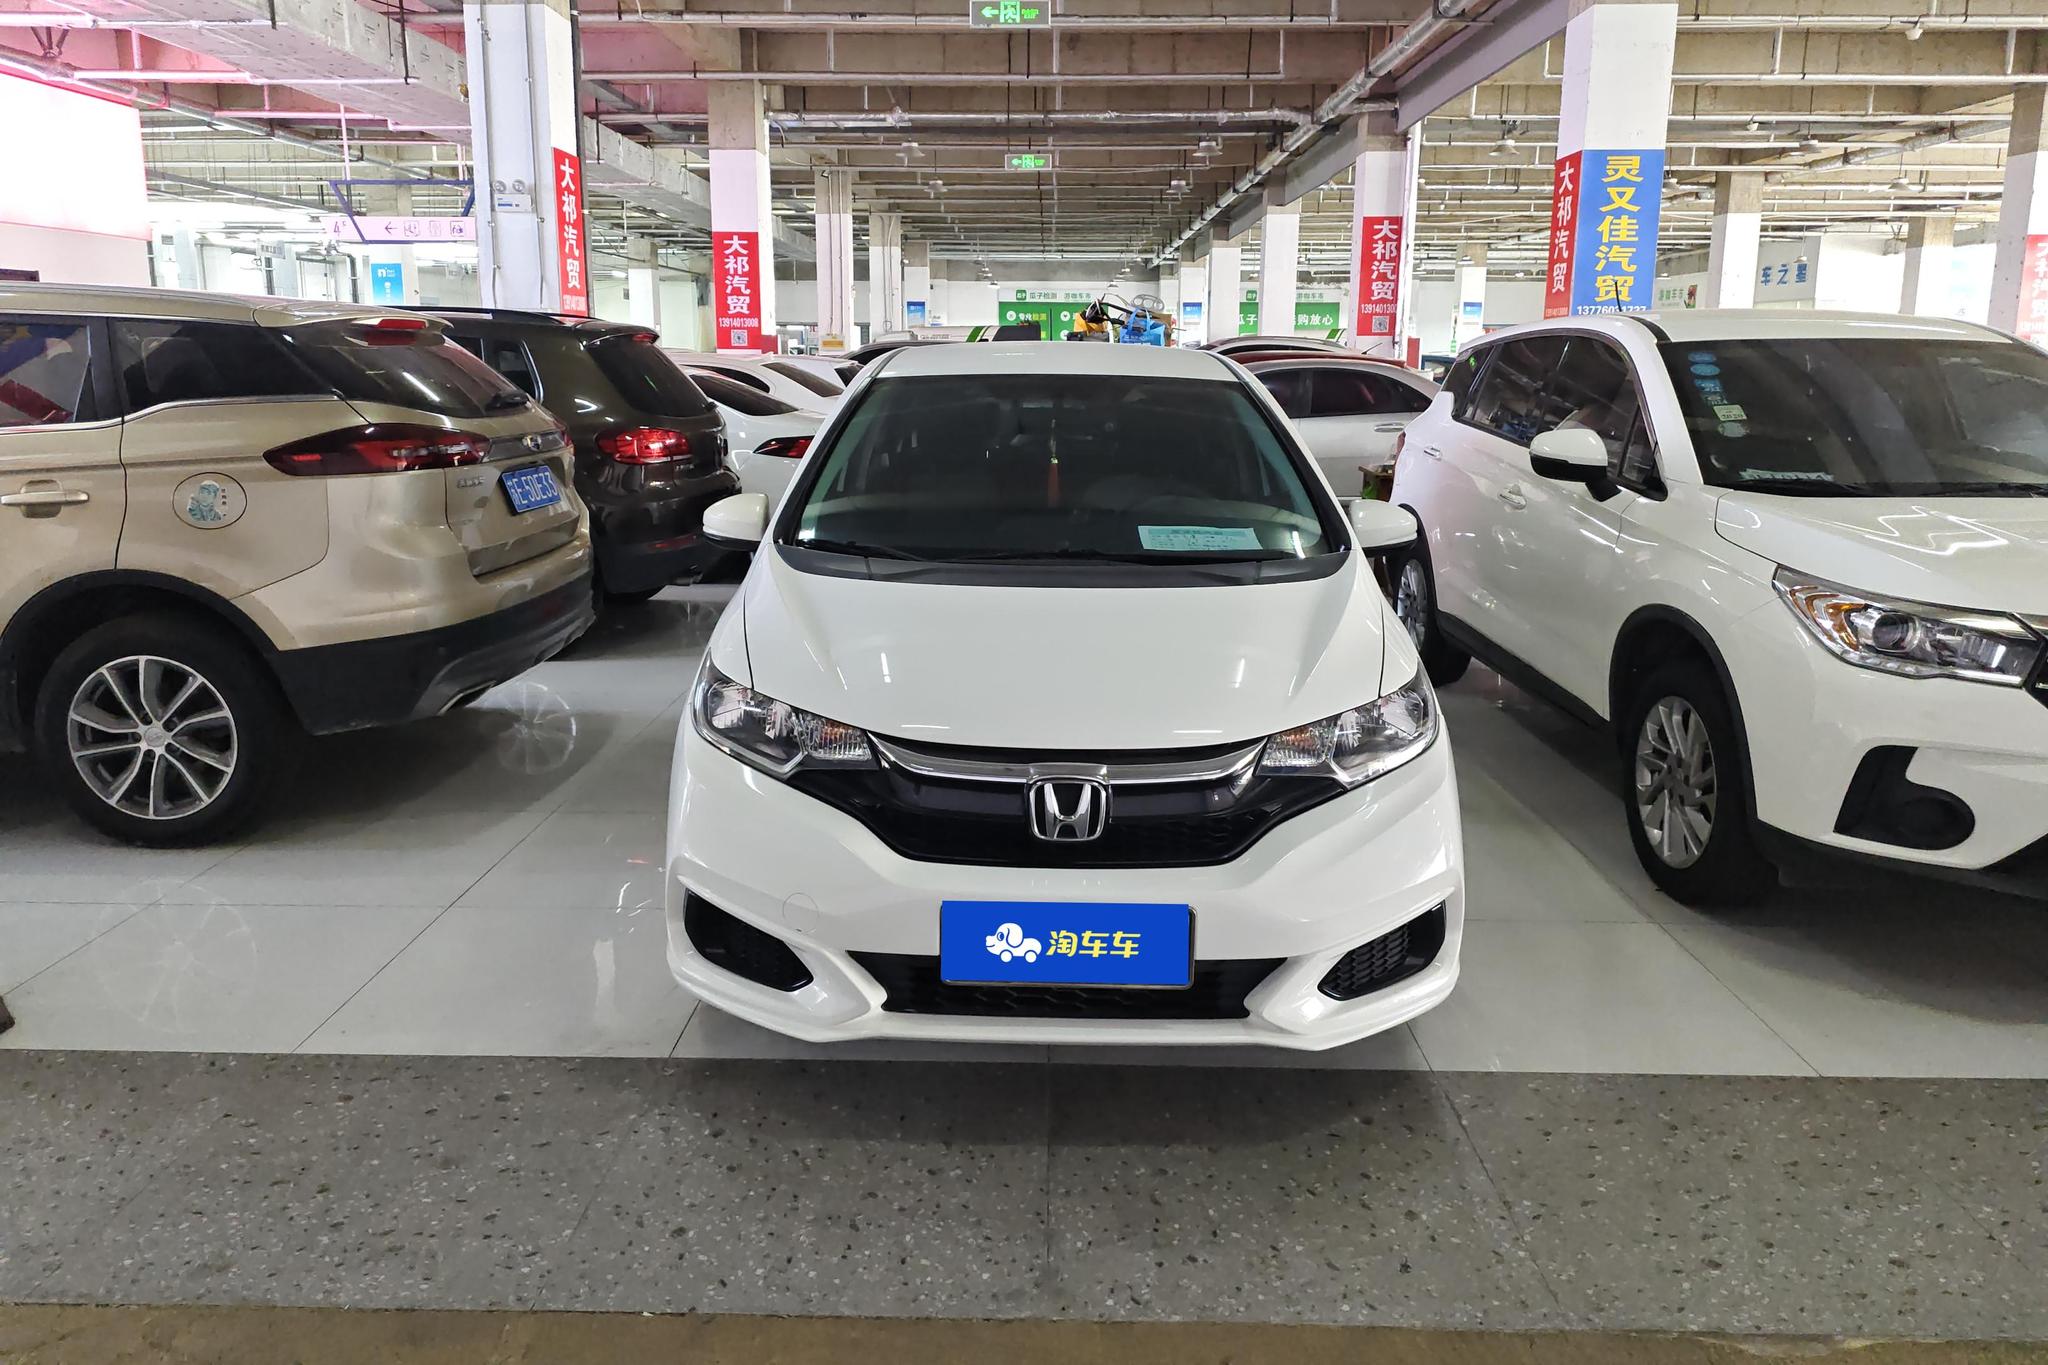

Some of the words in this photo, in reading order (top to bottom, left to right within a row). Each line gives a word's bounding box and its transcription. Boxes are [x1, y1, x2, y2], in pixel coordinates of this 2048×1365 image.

[560, 158, 580, 289] 大祁汽贸
[1370, 220, 1398, 300] 大祁汽贸
[1552, 161, 1575, 293] 大祁汽贸
[1594, 155, 1644, 302] 灵又佳汽贸
[723, 235, 751, 314] 大祁汽贸
[1761, 263, 1807, 286] 车之星
[1294, 313, 1333, 326] 购放心
